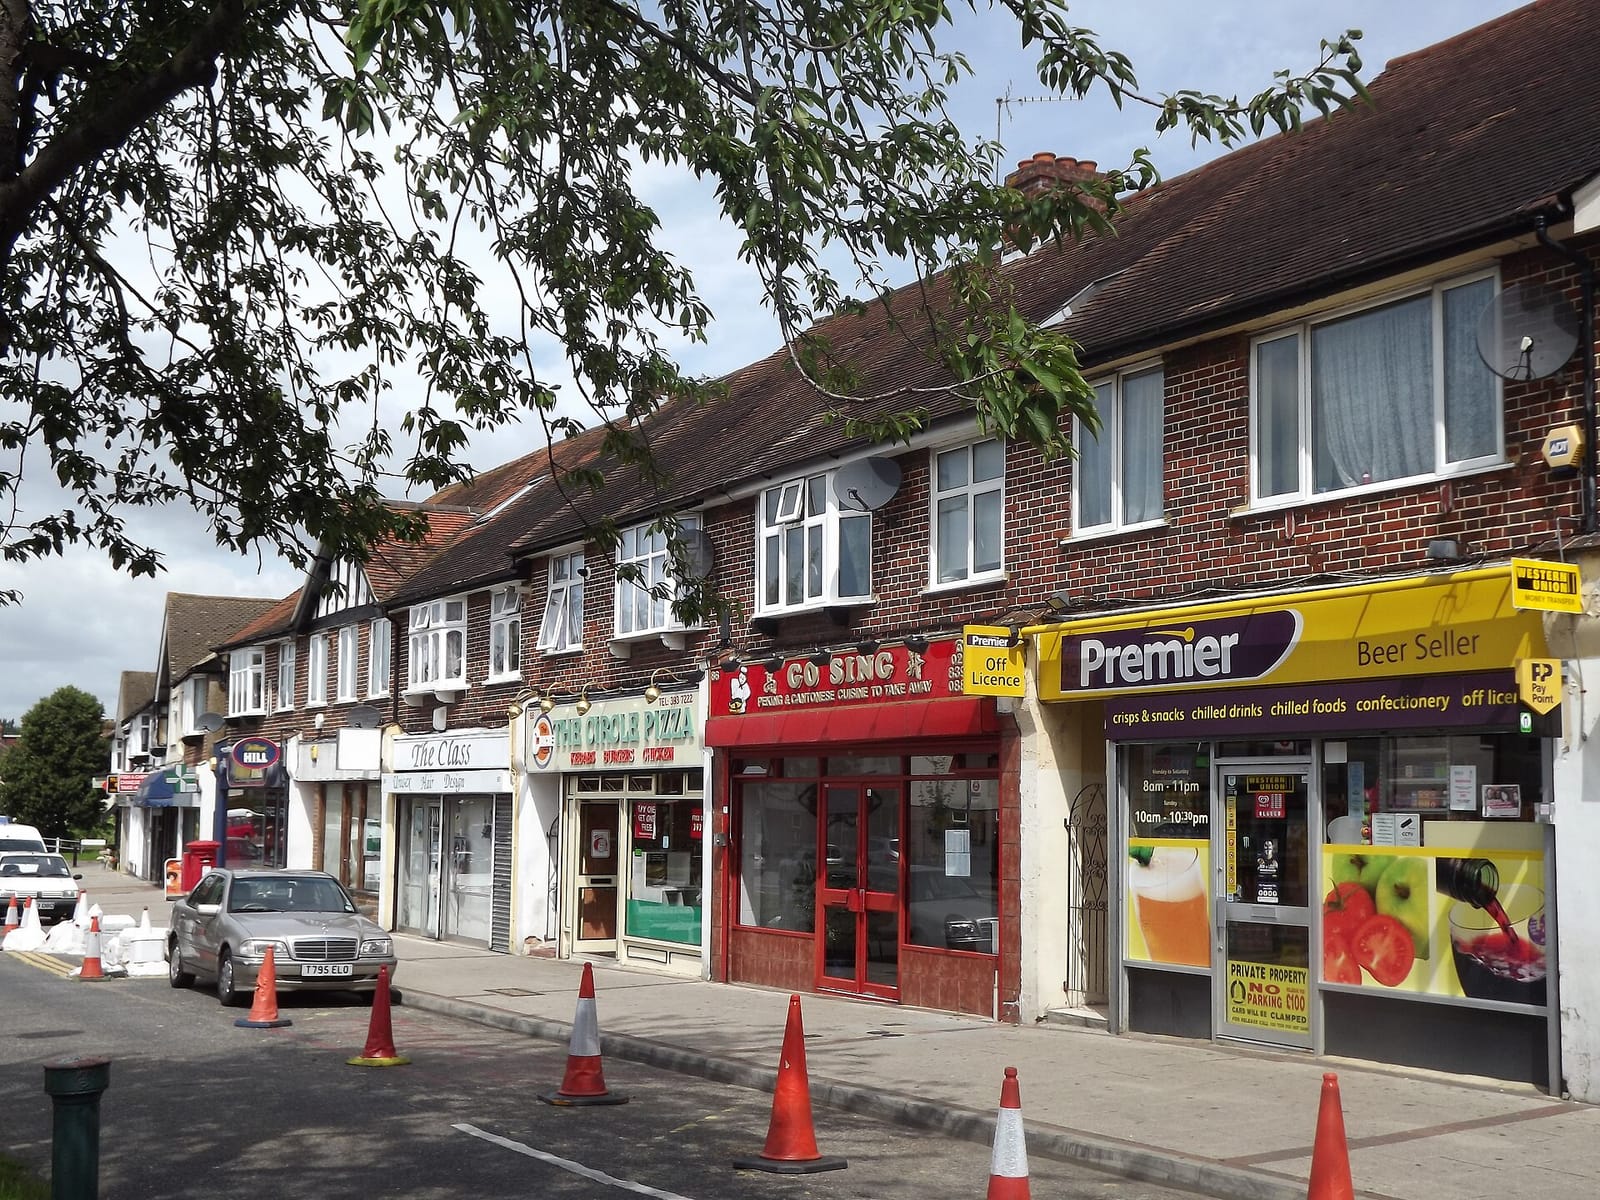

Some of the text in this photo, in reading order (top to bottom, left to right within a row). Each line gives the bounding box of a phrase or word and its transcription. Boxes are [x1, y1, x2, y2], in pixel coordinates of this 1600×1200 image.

[1550, 440, 1568, 454] ADT
[1516, 567, 1568, 582] WESTERN
[1532, 580, 1568, 593] UNION
[1524, 594, 1575, 605] MONEY TRANSFER
[972, 635, 1009, 647] Premier
[1357, 629, 1480, 666] Beer Seller
[951, 652, 964, 665] 02
[985, 657, 1007, 671] Off
[1080, 627, 1239, 687] Premier
[786, 661, 819, 690] GO
[830, 651, 895, 686] SING
[972, 672, 1021, 687] Licence
[757, 679, 932, 708] PEKING & CANTONESE CUISINE TO TAKE AWAY
[1532, 683, 1546, 694] Pay
[680, 694, 693, 705] 7222
[1532, 694, 1554, 704] Point
[1112, 710, 1139, 726] crisps
[1141, 709, 1150, 722] &
[1151, 707, 1185, 722] snacks
[1191, 704, 1227, 720] chilled
[1229, 703, 1263, 718] drinks
[1270, 698, 1309, 716] chilled
[1312, 697, 1347, 714] foods
[1356, 694, 1450, 711] confectionery
[1462, 689, 1484, 706] off
[553, 706, 695, 748] THE CIRCLE PIZZA
[243, 752, 269, 764] HILL
[411, 739, 472, 768] The Class
[603, 748, 635, 764] BURGERS
[642, 747, 675, 763] CHICKEN
[421, 775, 434, 790] Hair
[443, 773, 465, 793] Design
[1143, 780, 1164, 793] 8am
[1172, 780, 1200, 795] 11pm
[1248, 776, 1285, 784] WESTERN
[1135, 811, 1161, 823] 10am
[1170, 811, 1208, 826] 10:30pm
[306, 965, 329, 975] T795
[1231, 964, 1307, 984] PRIVATE PROPERTY
[1249, 982, 1281, 995] NO
[1247, 993, 1306, 1012] PARKING £100
[1232, 1006, 1245, 1014] CARS
[1247, 1008, 1259, 1016] WILL
[1270, 1011, 1307, 1023] CLAMPED
